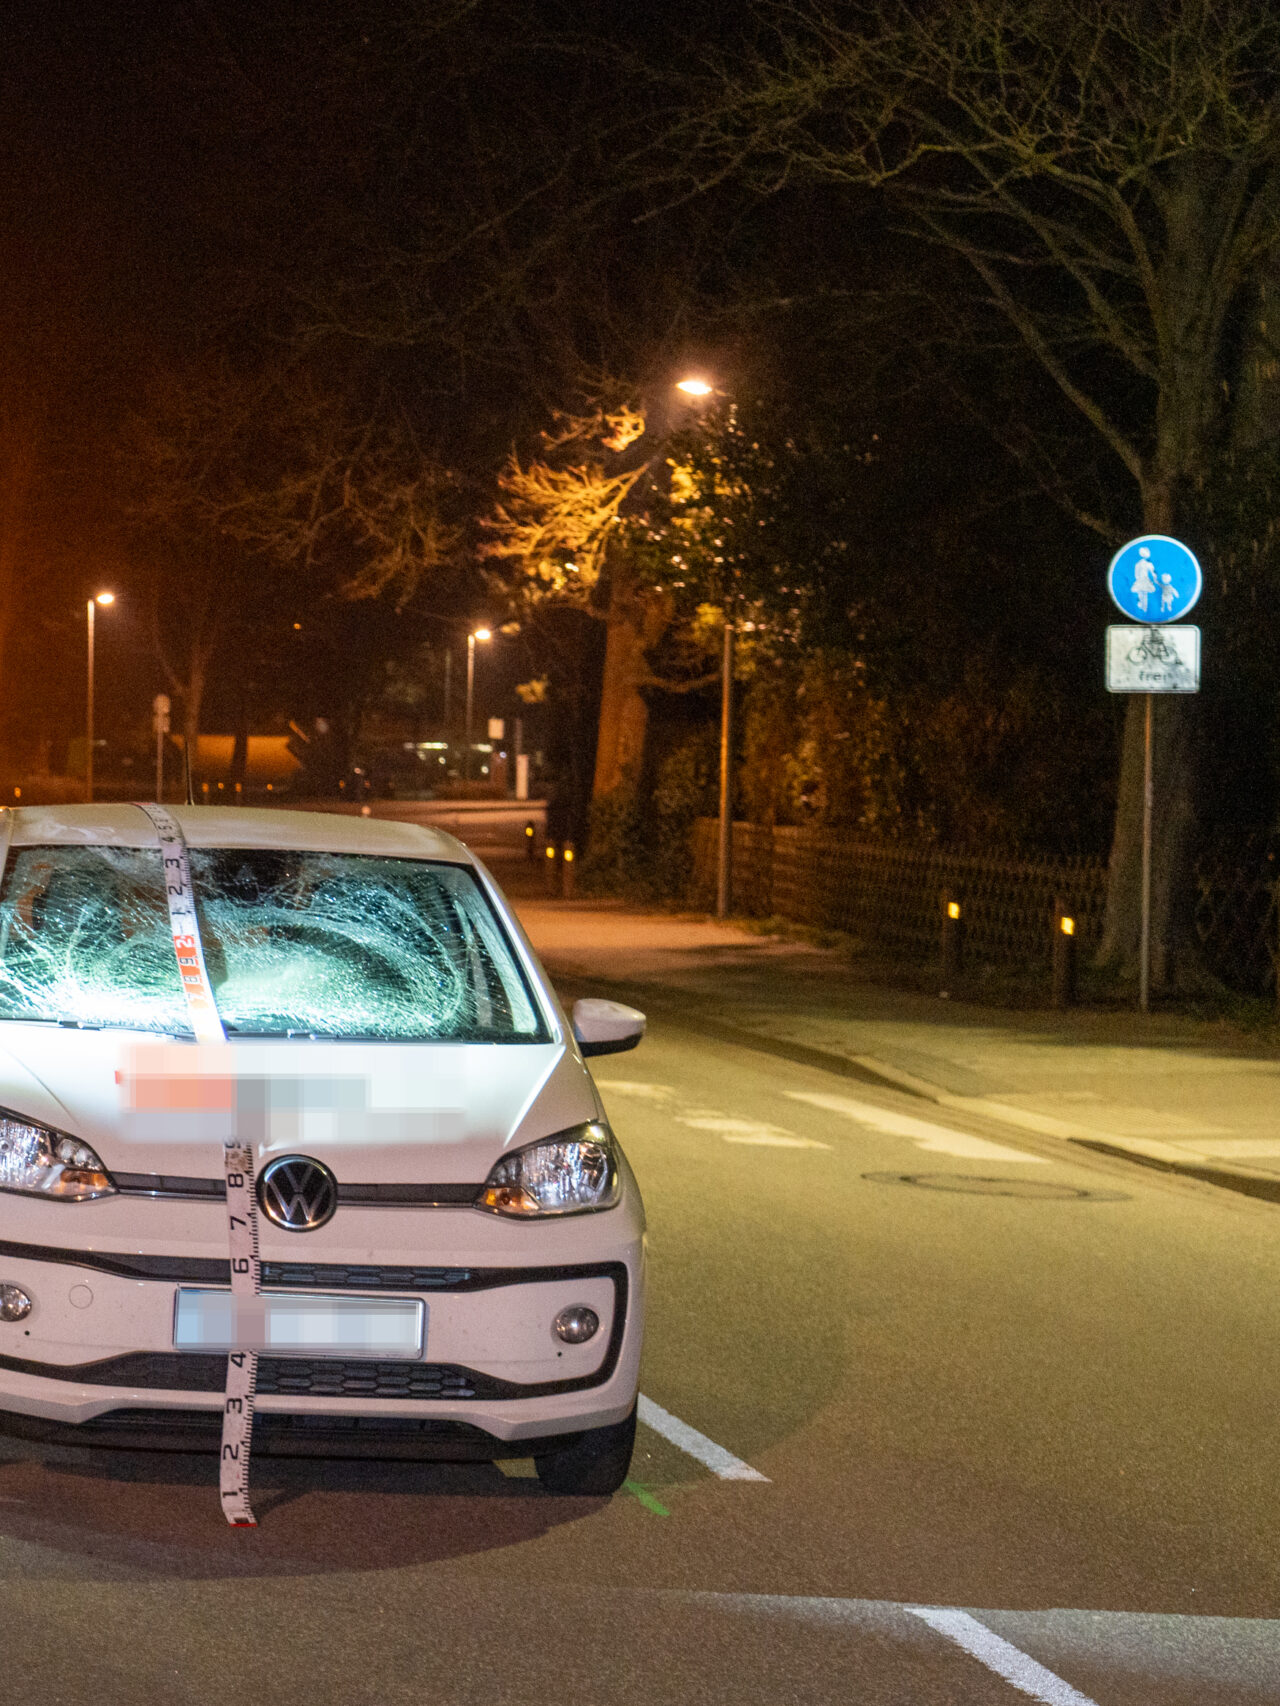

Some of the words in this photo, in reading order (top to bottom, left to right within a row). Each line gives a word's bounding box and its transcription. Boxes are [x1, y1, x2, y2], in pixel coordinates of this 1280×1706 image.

[165, 858, 180, 869] 3
[168, 885, 183, 896] 2
[227, 1173, 245, 1188] 8
[263, 1156, 334, 1230] VW
[229, 1215, 247, 1231] 7
[232, 1257, 249, 1274] 6
[230, 1351, 246, 1368] 4
[226, 1397, 243, 1414] 3
[223, 1443, 239, 1460] 2
[222, 1490, 238, 1499] 1
